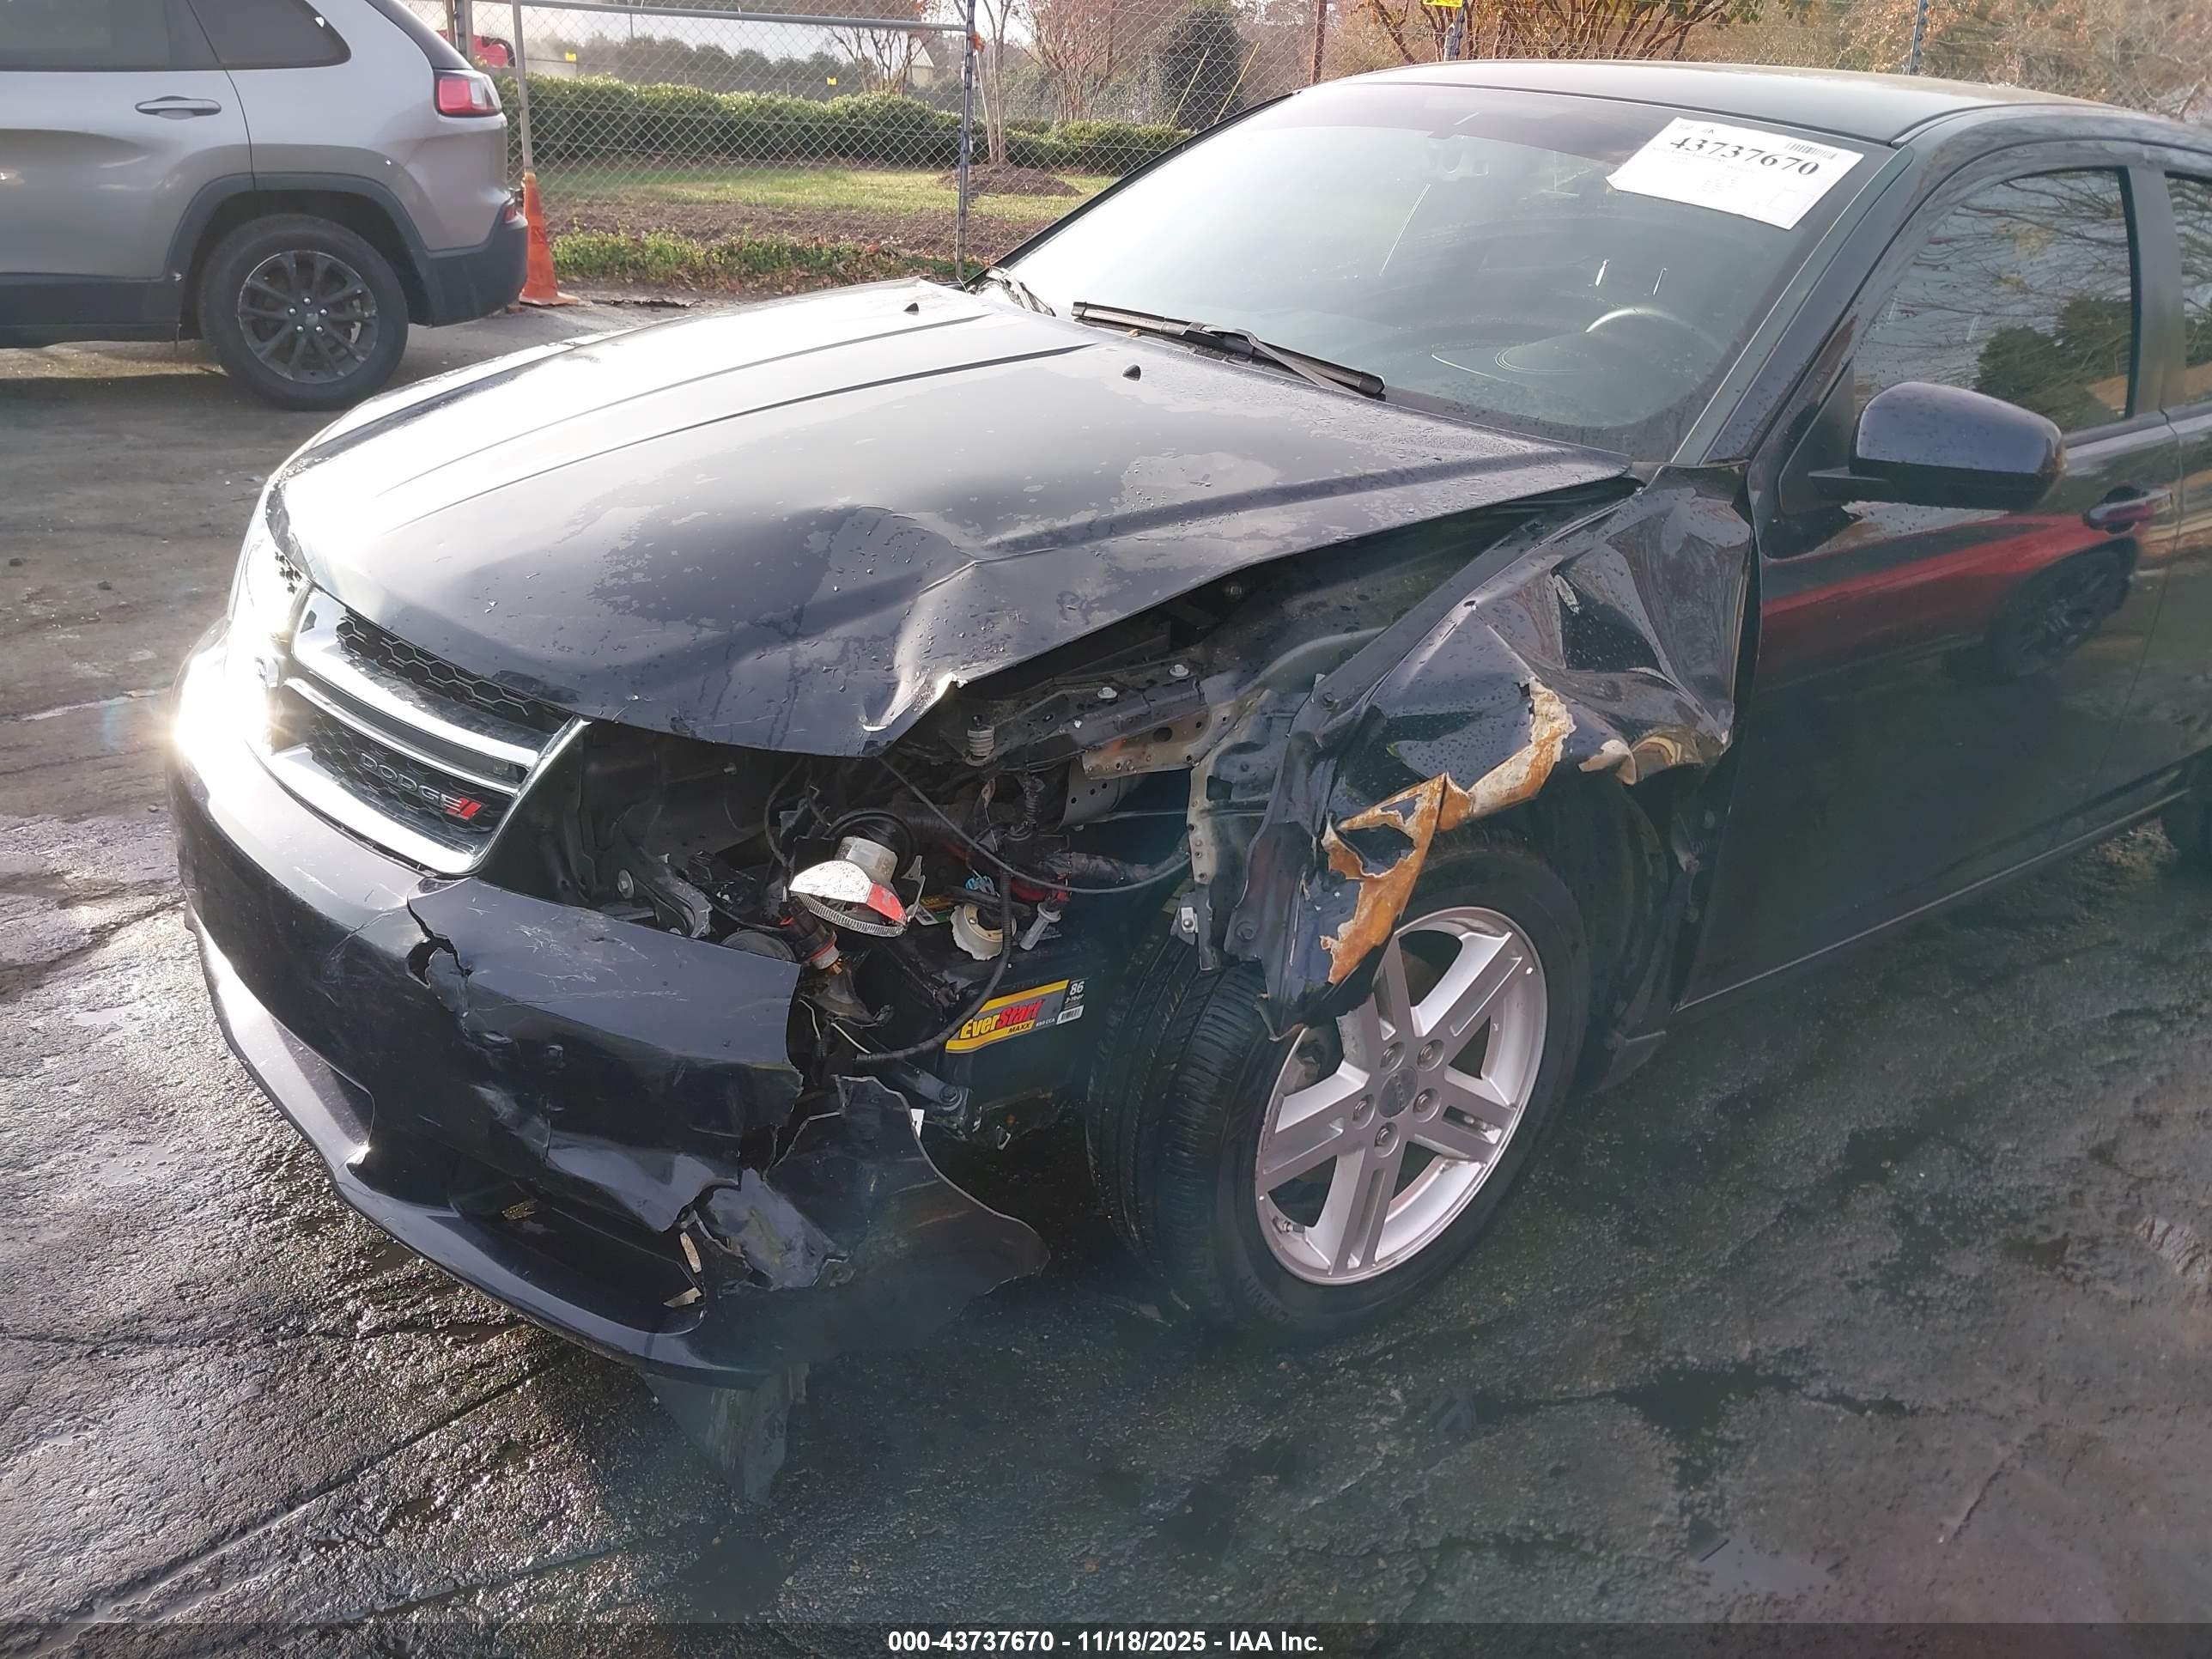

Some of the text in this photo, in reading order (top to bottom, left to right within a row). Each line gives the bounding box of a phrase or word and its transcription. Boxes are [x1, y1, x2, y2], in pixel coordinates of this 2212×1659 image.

[1669, 137, 1820, 175] 43737670
[361, 752, 462, 812] DODGE
[1069, 981, 1085, 995] 86
[959, 1000, 1044, 1039] EverStart
[1007, 1022, 1031, 1034] MAXX
